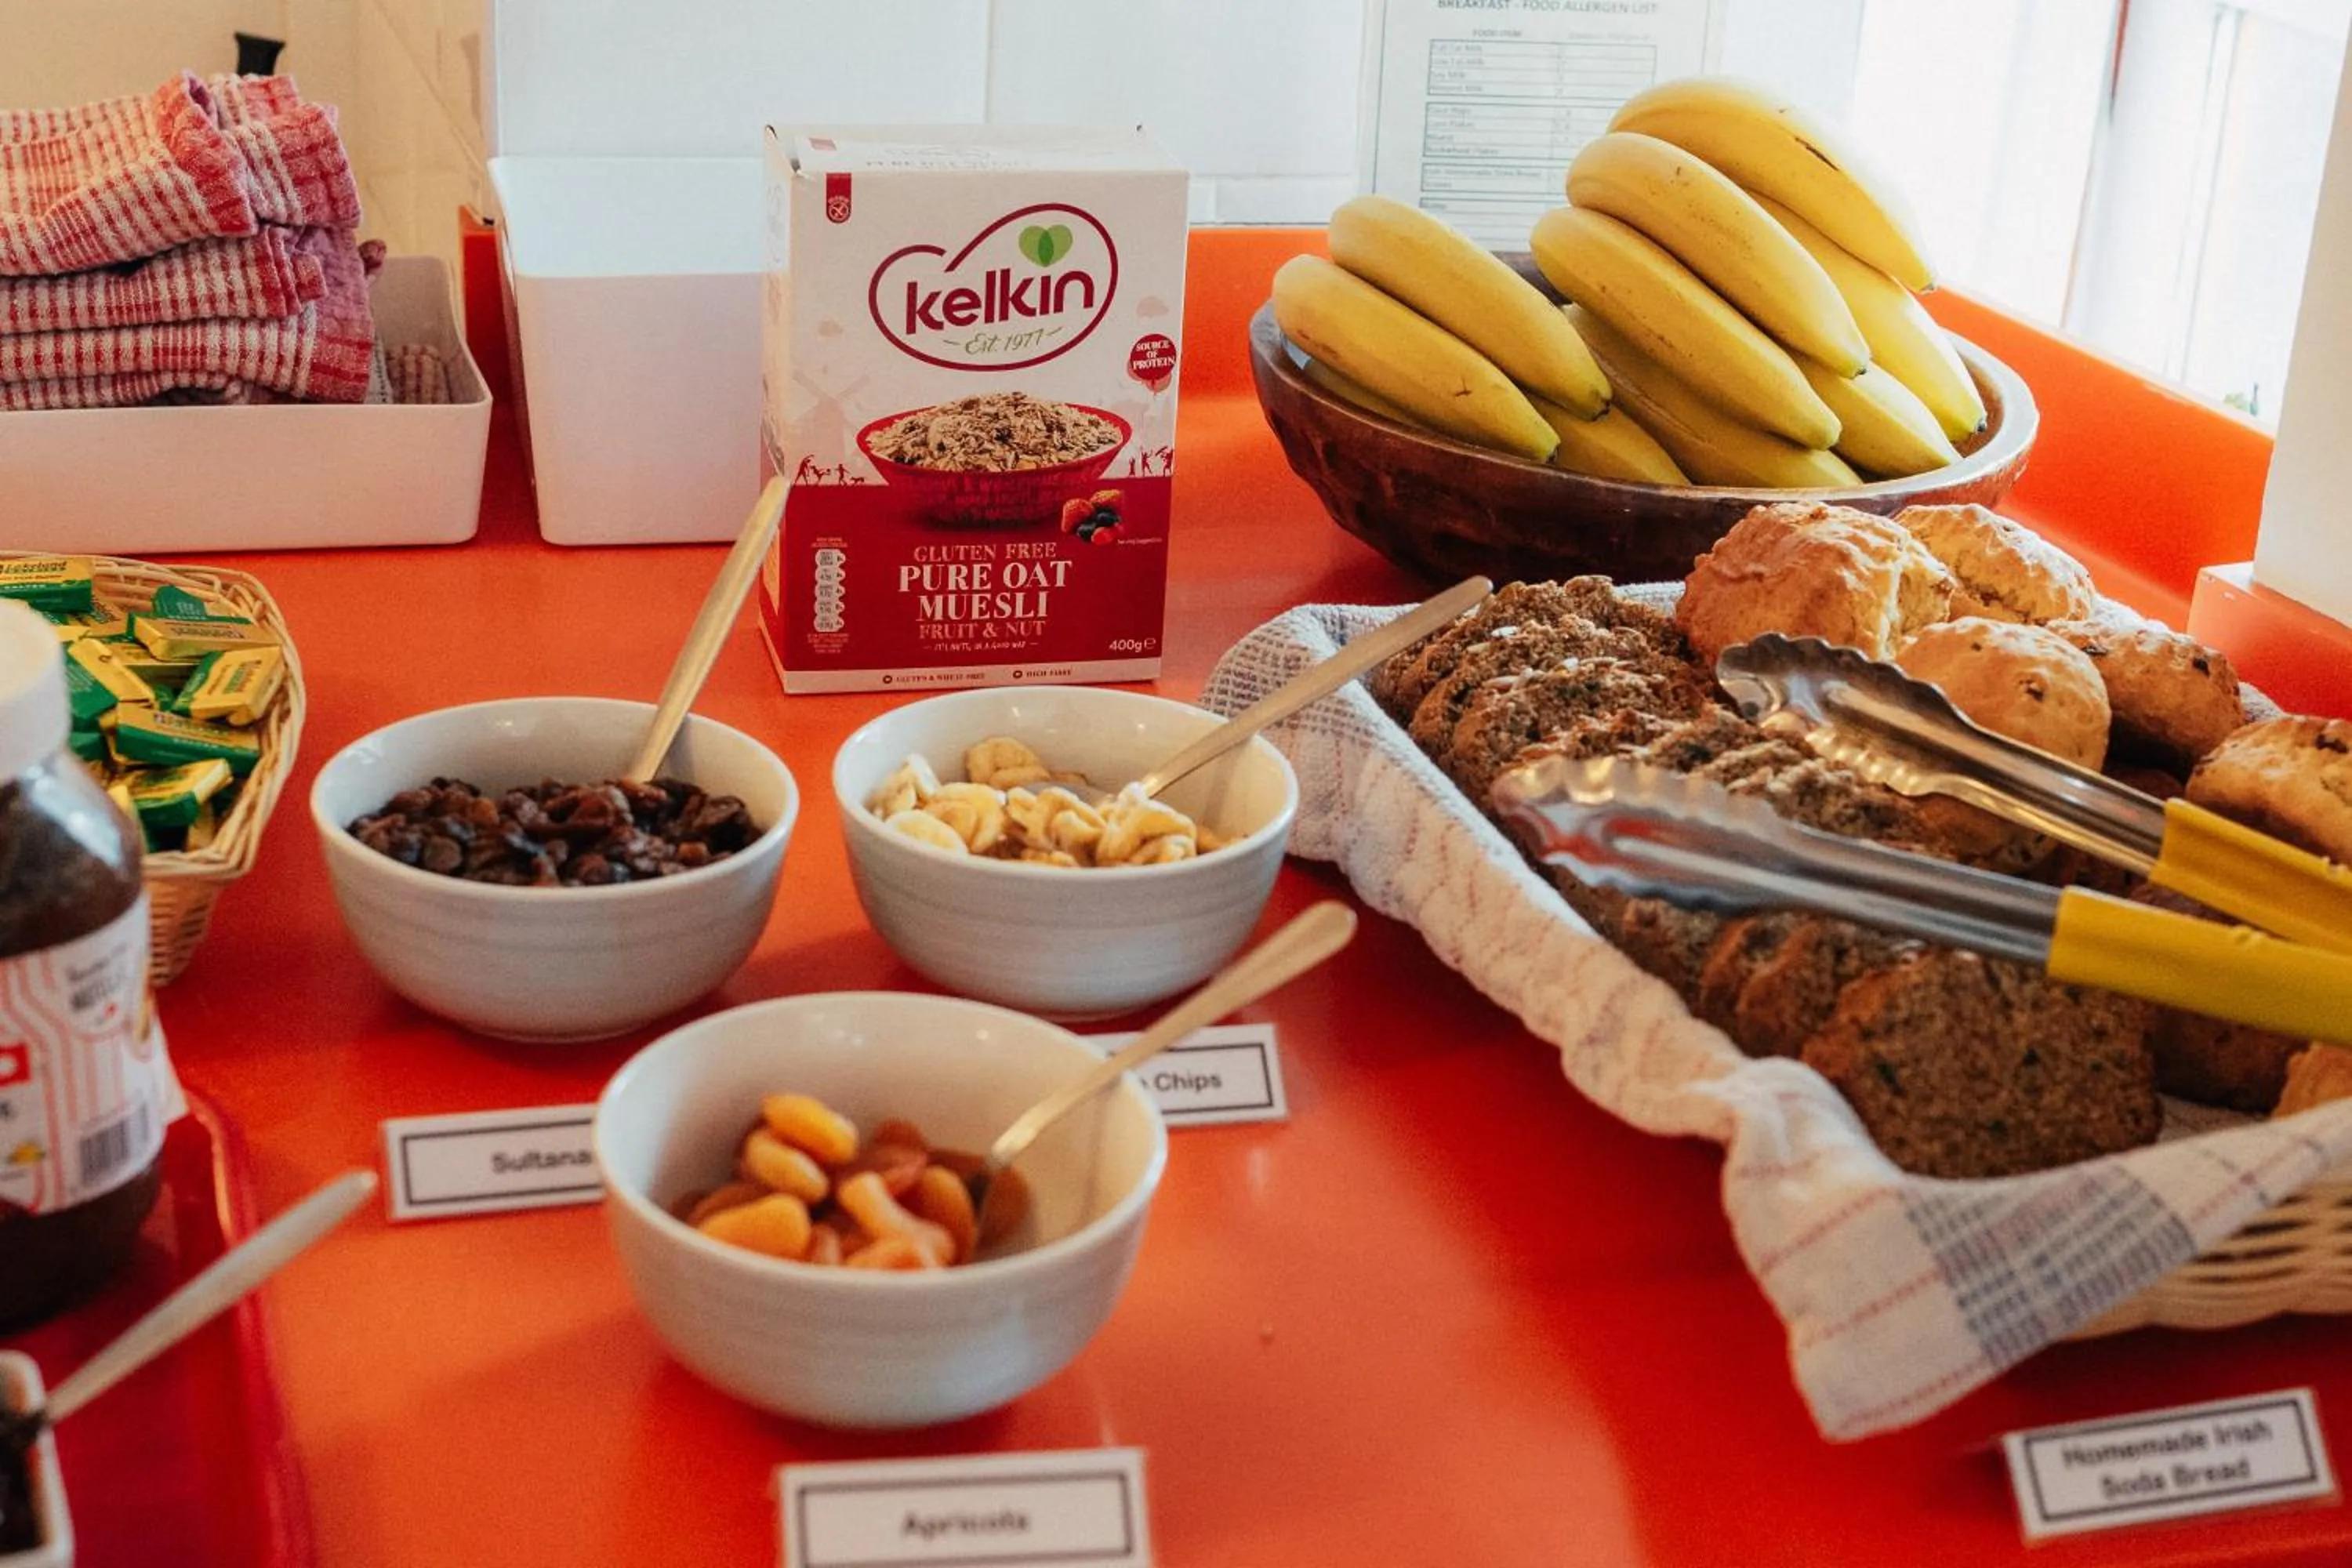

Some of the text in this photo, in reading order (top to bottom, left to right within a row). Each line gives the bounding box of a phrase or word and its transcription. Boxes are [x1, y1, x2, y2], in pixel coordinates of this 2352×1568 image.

[1522, 1, 1559, 12] FOOD
[1564, 2, 1628, 13] ALLERGEN
[1632, 3, 1658, 14] LIST
[906, 267, 1095, 335] kelkin
[1136, 339, 1171, 351] SOURCE
[1146, 350, 1158, 358] OF
[1133, 355, 1176, 371] PROTEIN
[913, 542, 1057, 562] GLUTEN FREE
[898, 561, 1073, 592] PURE OAT
[916, 590, 1050, 622] MUESLI
[919, 620, 1046, 639] FRUIT & NUT
[1109, 639, 1142, 653] 400g
[1154, 1071, 1223, 1093] Chips
[2063, 1419, 2273, 1468] Homemade Irish
[2100, 1457, 2252, 1499] Soda Bread
